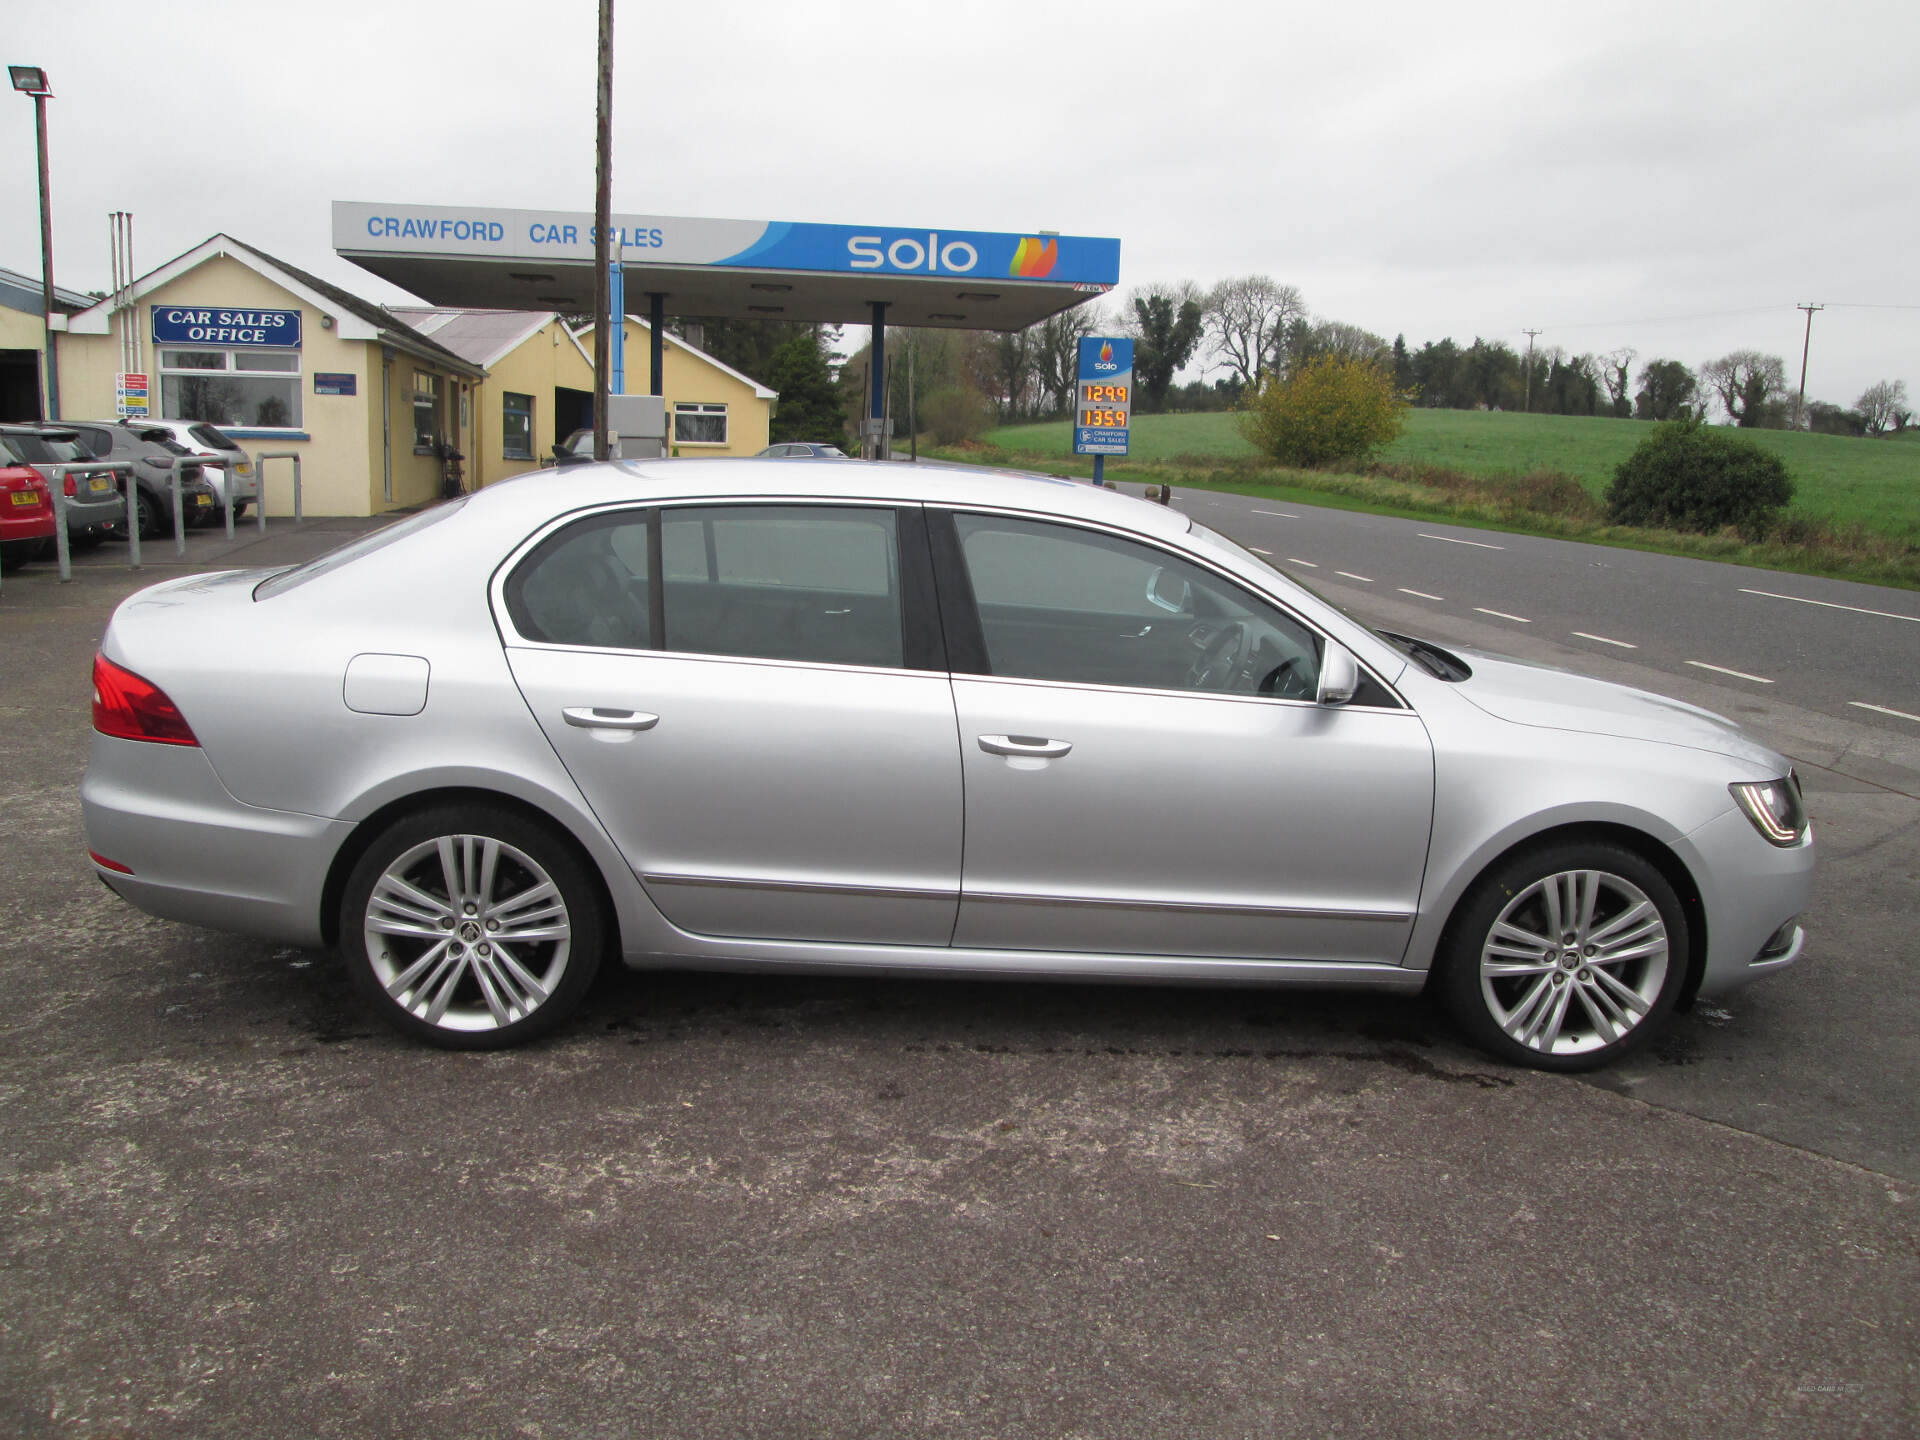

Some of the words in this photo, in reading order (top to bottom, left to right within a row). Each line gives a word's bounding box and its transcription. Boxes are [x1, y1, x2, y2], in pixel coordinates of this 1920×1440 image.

[367, 216, 504, 241] CRAWFORD
[529, 223, 578, 244] CAR
[847, 233, 979, 272] solo
[167, 311, 212, 325] CAR
[218, 312, 286, 327] SALES
[188, 327, 267, 342] OFFICE
[1094, 362, 1118, 370] solo
